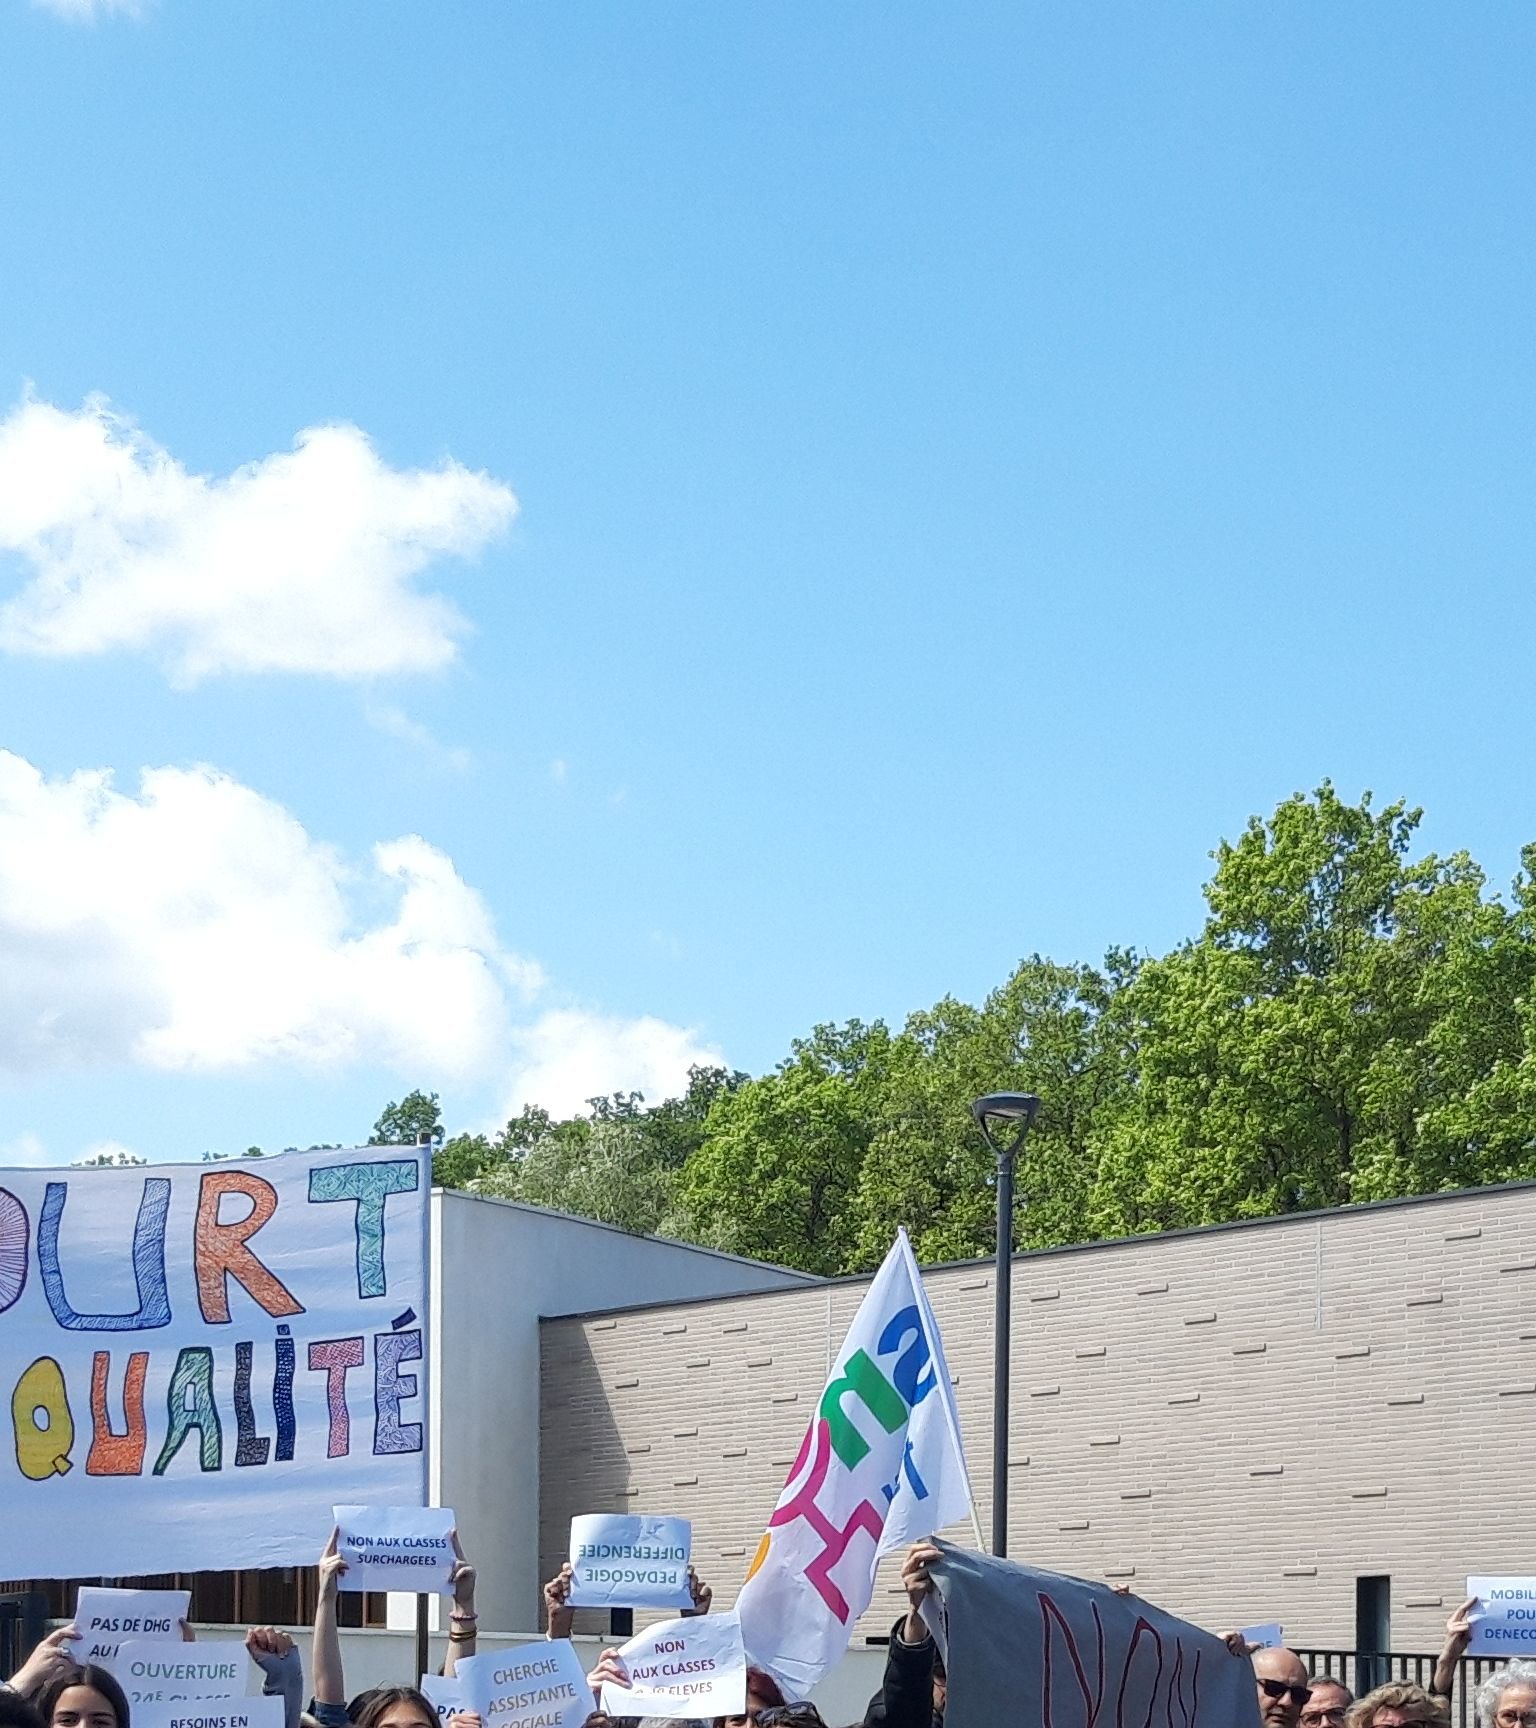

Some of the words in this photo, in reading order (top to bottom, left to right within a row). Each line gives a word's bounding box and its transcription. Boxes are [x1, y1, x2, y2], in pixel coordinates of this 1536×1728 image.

[11, 1307, 422, 1481] QUALITÉ
[347, 1536, 373, 1546] NON
[377, 1537, 400, 1547] AUX
[403, 1538, 447, 1548] CLASSES
[357, 1554, 437, 1566] SURCHARGEES
[579, 1544, 685, 1560] DIFFERENCIEE
[585, 1568, 677, 1584] PEDAGOGIE
[90, 1617, 119, 1632] PAS
[122, 1618, 141, 1632] DE
[144, 1618, 171, 1632] DHG
[89, 1643, 112, 1657] AU
[654, 1639, 685, 1654] NON
[130, 1661, 237, 1679] OUVERTURE
[493, 1658, 560, 1686] CHERCHE
[632, 1668, 659, 1681] AUX
[662, 1658, 716, 1676] CLASSES
[488, 1682, 576, 1715] ASSISTANTE
[230, 1715, 248, 1728] EN
